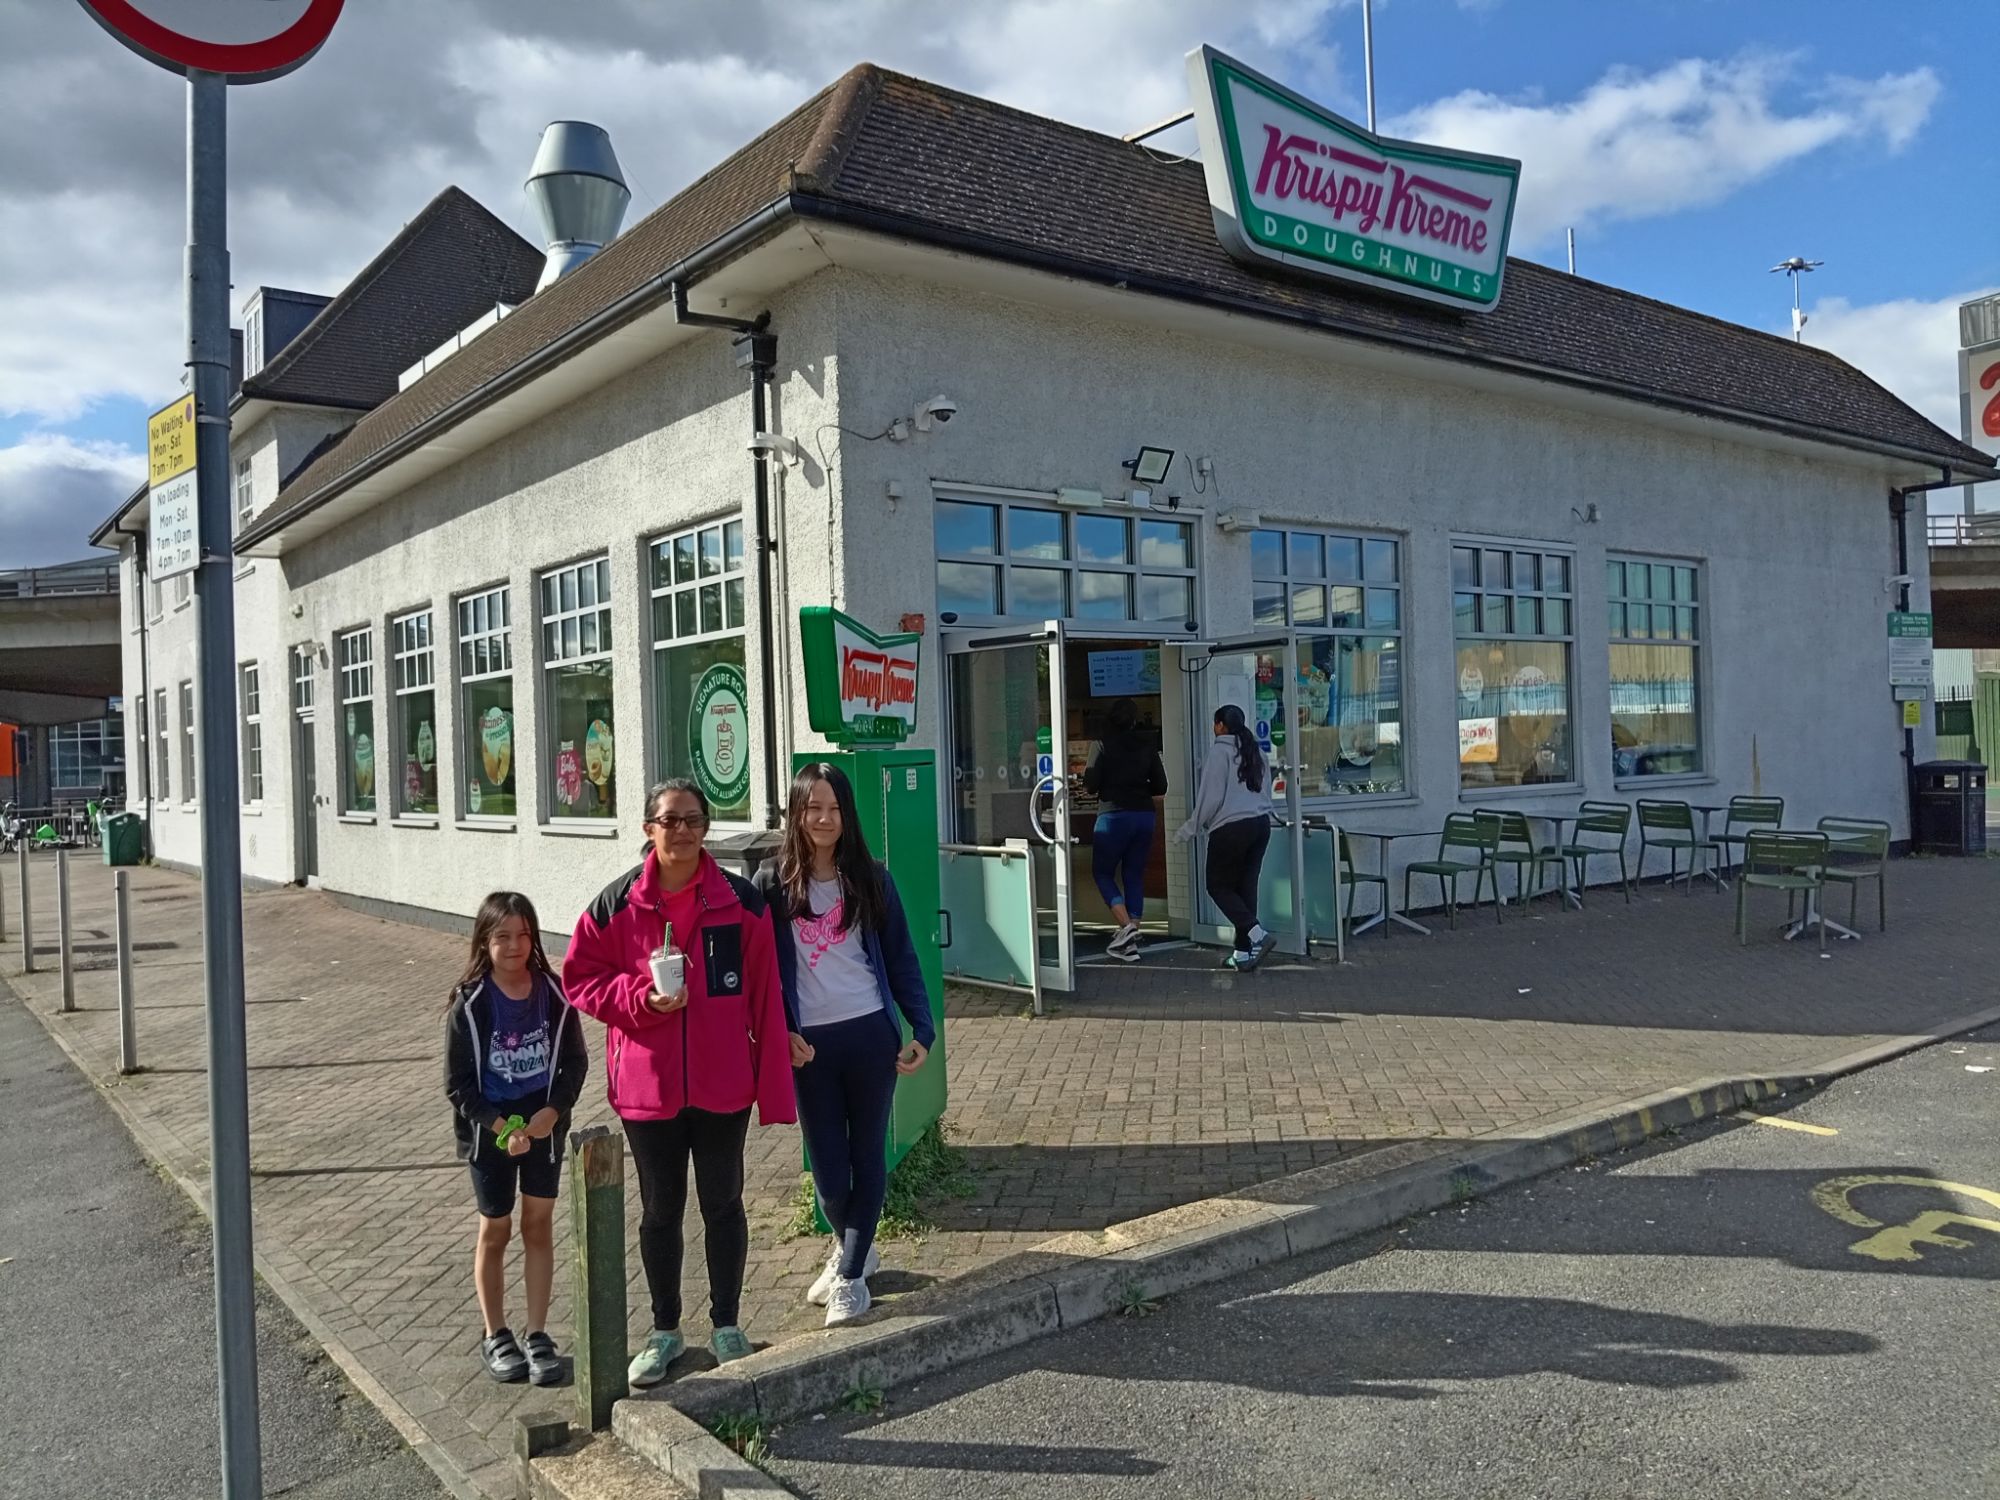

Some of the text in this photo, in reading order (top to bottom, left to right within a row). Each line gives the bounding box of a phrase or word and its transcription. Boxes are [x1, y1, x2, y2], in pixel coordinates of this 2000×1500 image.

[1254, 123, 1493, 254] Krispy Kreme
[1263, 214, 1483, 294] DOUGHNUTS
[151, 415, 183, 440] No Waiting
[157, 484, 189, 506] No loading
[695, 673, 730, 714] SIGNATURE
[841, 645, 916, 712] Krispy Kreme
[695, 750, 719, 796] RAINFOREST
[719, 781, 742, 799] ALLIANCE
[512, 1055, 545, 1073] 2024
